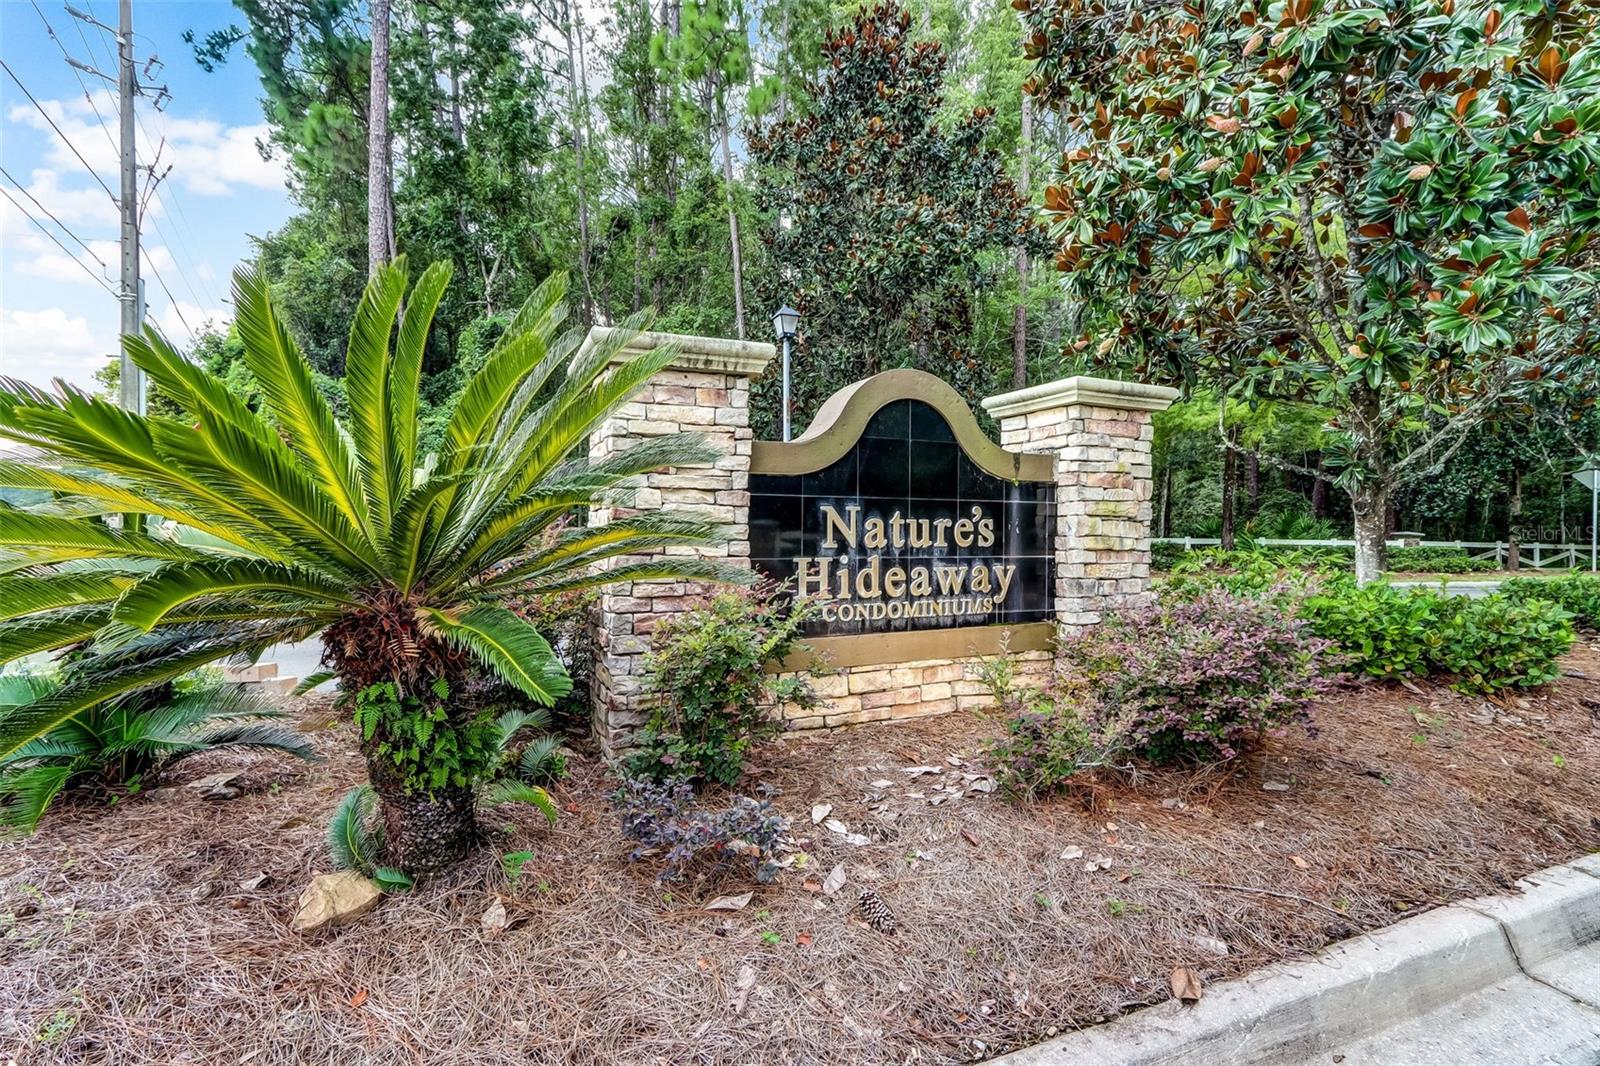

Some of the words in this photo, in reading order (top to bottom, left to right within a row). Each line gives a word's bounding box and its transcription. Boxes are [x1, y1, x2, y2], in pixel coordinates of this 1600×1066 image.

[820, 505, 995, 549] Nature's
[793, 554, 1017, 604] Hideaway
[822, 598, 993, 622] CONDOMINIUMS
